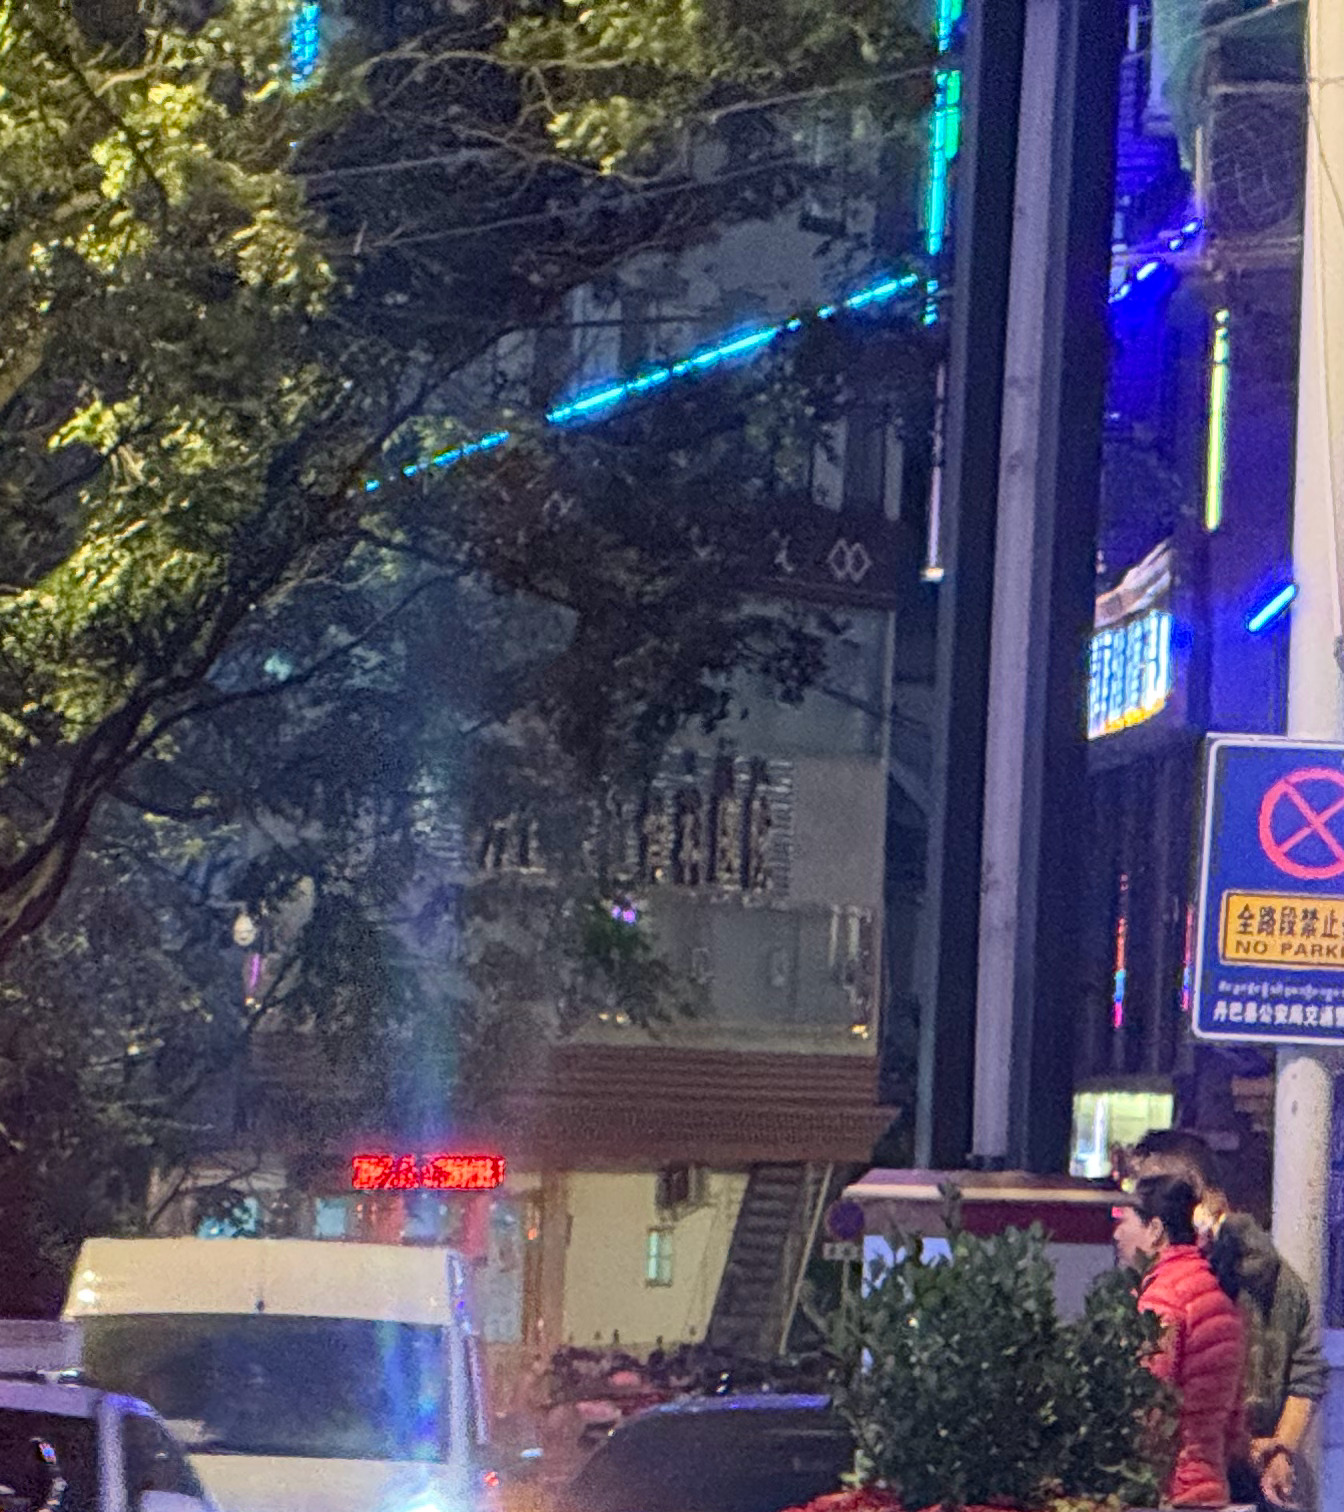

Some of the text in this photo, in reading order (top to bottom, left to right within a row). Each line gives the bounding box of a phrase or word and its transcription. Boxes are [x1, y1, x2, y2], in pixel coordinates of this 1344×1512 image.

[1235, 903, 1344, 939] 全路段禁止
[1235, 940, 1269, 955] NO
